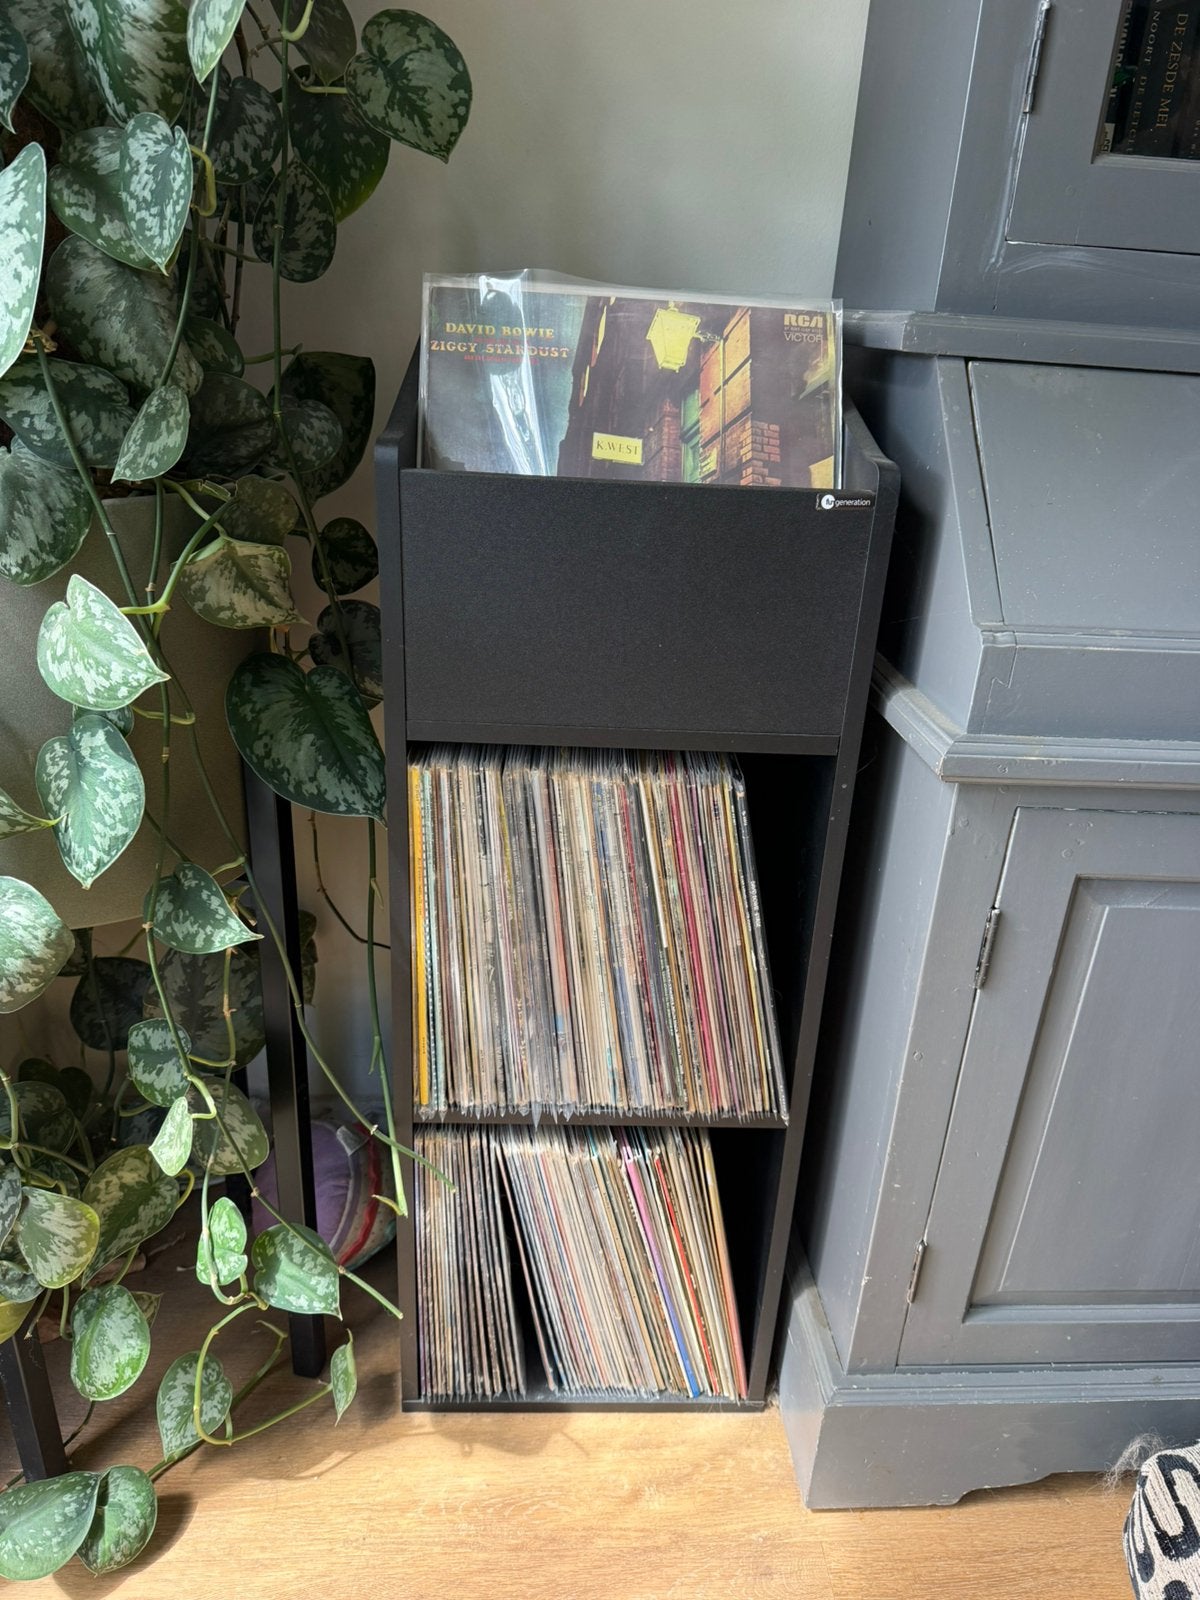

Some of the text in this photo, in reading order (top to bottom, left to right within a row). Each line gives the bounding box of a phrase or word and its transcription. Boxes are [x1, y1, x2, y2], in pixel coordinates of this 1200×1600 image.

[1144, 10, 1161, 63] NOORT
[1155, 13, 1189, 129] DE ZESDE MEI
[784, 313, 823, 328] RCA
[445, 322, 555, 340] DAVID BOWIE
[784, 332, 823, 343] VICTOR
[430, 340, 477, 353] ZIGGY
[485, 344, 570, 358] STARDUST
[596, 440, 638, 455] K.WEST
[835, 498, 871, 508] generation
